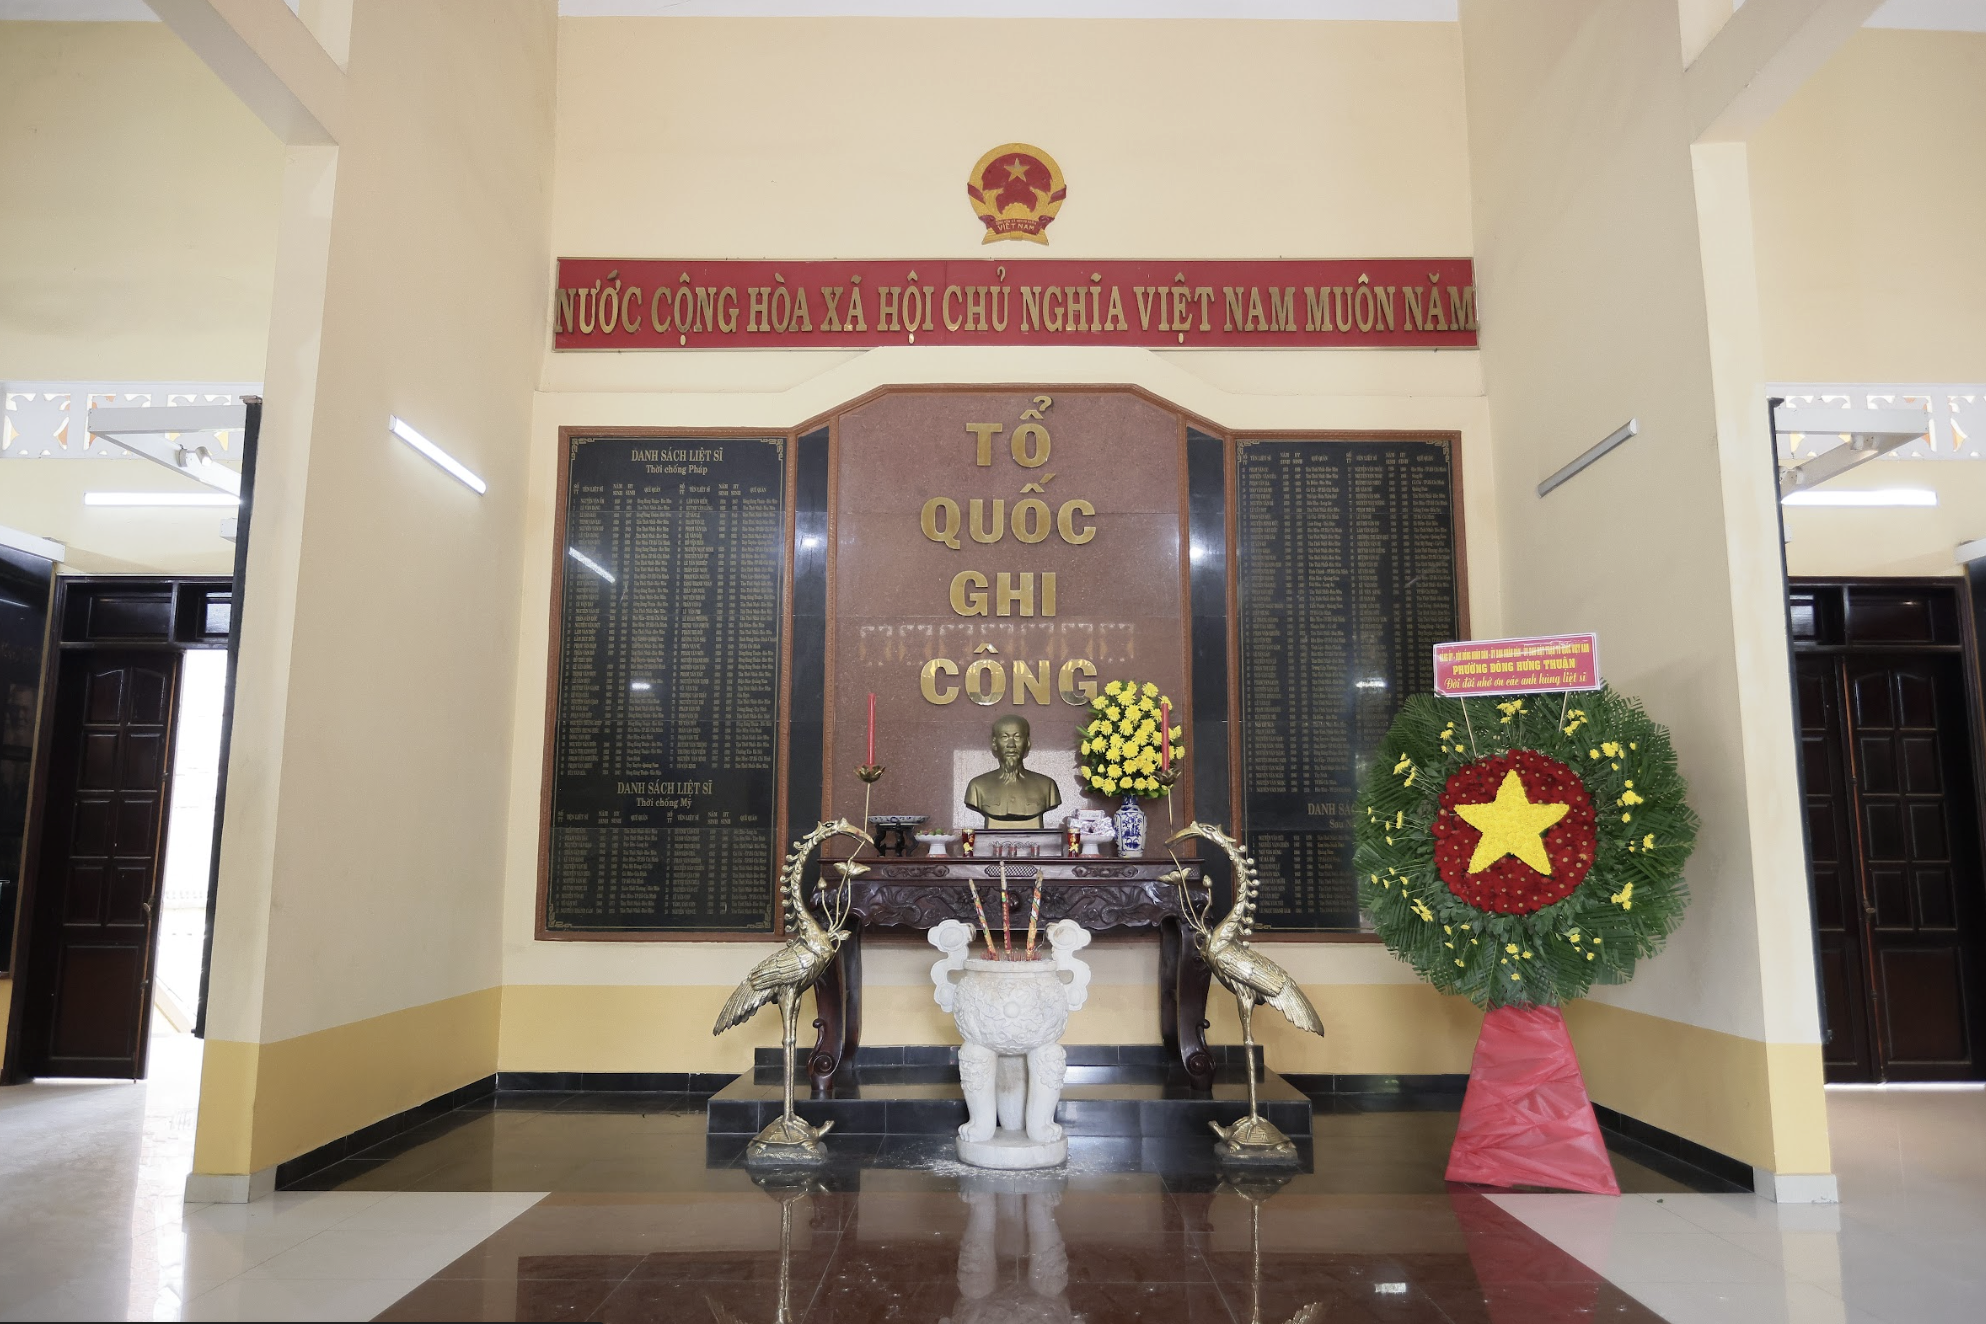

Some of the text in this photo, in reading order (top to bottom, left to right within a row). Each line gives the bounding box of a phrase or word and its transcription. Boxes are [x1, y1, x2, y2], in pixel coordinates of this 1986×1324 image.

[555, 266, 1478, 346] NƯỚC CỘNG HÒA XÃ HỘI CHỦ NGHĨA VIỆT NAM MUÔN NĂM
[965, 395, 1053, 468] TỔ
[631, 446, 724, 464] DANH SÁCH LIỆT SĨ
[646, 463, 708, 475] Thời chống Pháp
[920, 473, 1097, 550] QUỐC
[950, 570, 1057, 617] GHI
[920, 642, 1098, 706] CÔNG
[1452, 656, 1576, 675] PHƯỜNG ĐÔNG HƯNG THUẬN
[1520, 672, 1537, 686] anh
[1538, 672, 1560, 686] hùng
[617, 779, 713, 797] DANH SÁCH LIỆT SĨ
[636, 797, 654, 807] Thời
[655, 796, 679, 809] chống
[1307, 802, 1335, 815] DANH
